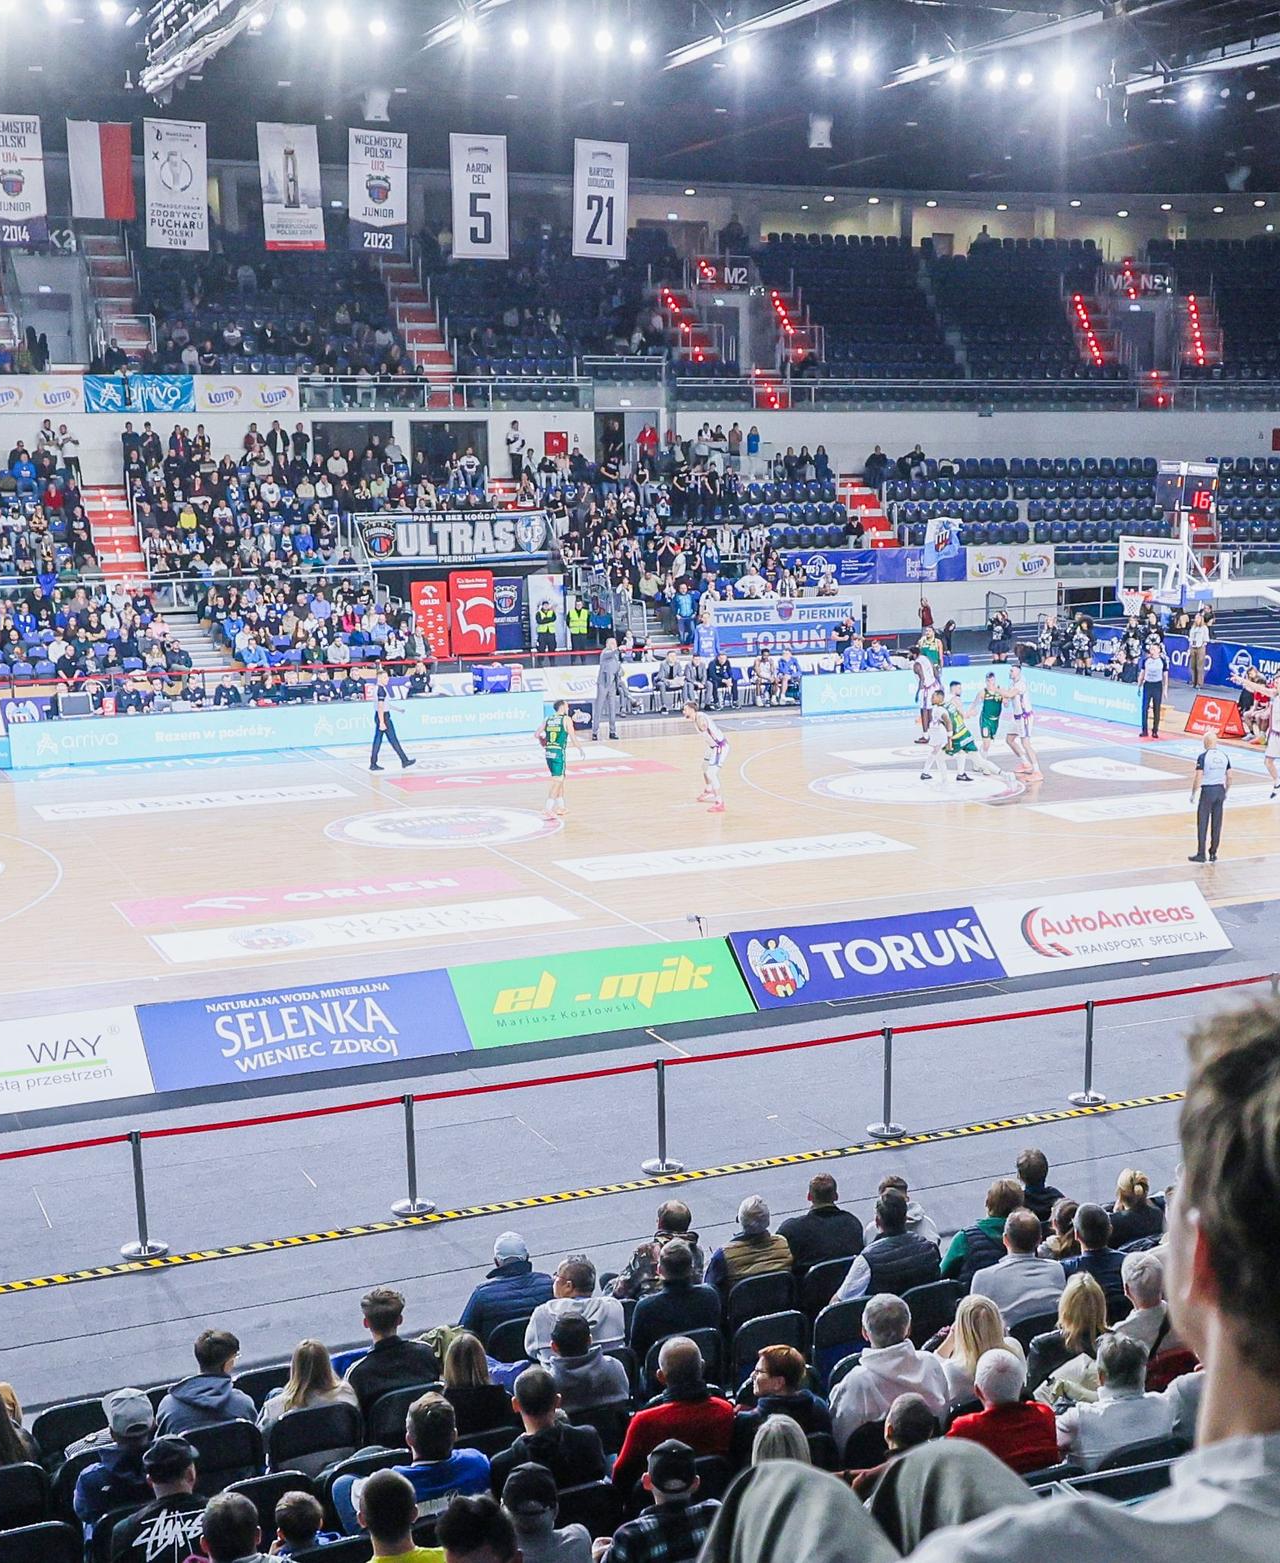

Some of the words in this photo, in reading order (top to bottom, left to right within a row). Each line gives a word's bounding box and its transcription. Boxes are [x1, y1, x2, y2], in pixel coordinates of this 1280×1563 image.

[355, 134, 402, 148] WICEMISTRZ
[364, 146, 392, 159] POLSKI
[465, 162, 492, 174] AARON
[472, 174, 486, 185] CEL
[150, 209, 203, 219] ZDOBYWCY
[362, 206, 394, 218] JUNIOR
[469, 192, 492, 244] 5
[585, 195, 614, 246] 21
[150, 219, 204, 229] PUCHARU
[2, 225, 31, 242] 2014
[162, 229, 193, 237] POLSKI
[363, 232, 393, 249] 2023
[724, 266, 748, 284] M2
[43, 390, 72, 405] LOTTO
[207, 390, 235, 406] LOTTO
[261, 390, 287, 406] LOTTO
[1193, 491, 1210, 509] 16
[396, 520, 516, 556] ULTRAS
[438, 555, 476, 564] PIERNIKI
[1138, 548, 1177, 560] SUZUKI
[978, 561, 1001, 573] LOTTO
[1022, 560, 1045, 573] LOTTO
[714, 611, 770, 623] TWARDE
[798, 608, 853, 620] PIERNIKI
[742, 625, 826, 652] TORUŃ
[61, 732, 118, 750] arriva
[154, 729, 199, 742] Razem
[202, 729, 216, 740] w
[218, 724, 277, 742] podróży.
[335, 713, 373, 730] arriv
[419, 712, 463, 726] Razem
[466, 713, 480, 723] w
[481, 708, 532, 723] podróży.
[673, 849, 765, 867] Bank
[772, 835, 888, 858] Pekao
[283, 876, 461, 903] ORLEN
[1040, 902, 1196, 937] AutoAndreas
[809, 917, 995, 983] TORUŃ
[1075, 935, 1145, 956] TRANSPORT
[1148, 930, 1208, 949] SPEDYCJA
[205, 996, 280, 1013] NATURALNA
[280, 991, 320, 1004] WODA
[320, 982, 391, 999] MINERALNA
[496, 1013, 558, 1028] Mariusz
[561, 1002, 637, 1020] Kozłowski
[215, 997, 400, 1058] SELENKA
[27, 1035, 102, 1064] WAY
[234, 1041, 326, 1074] WIENIEC
[330, 1035, 399, 1056] ZDRÓJ
[26, 1066, 114, 1089] przestrzeń
